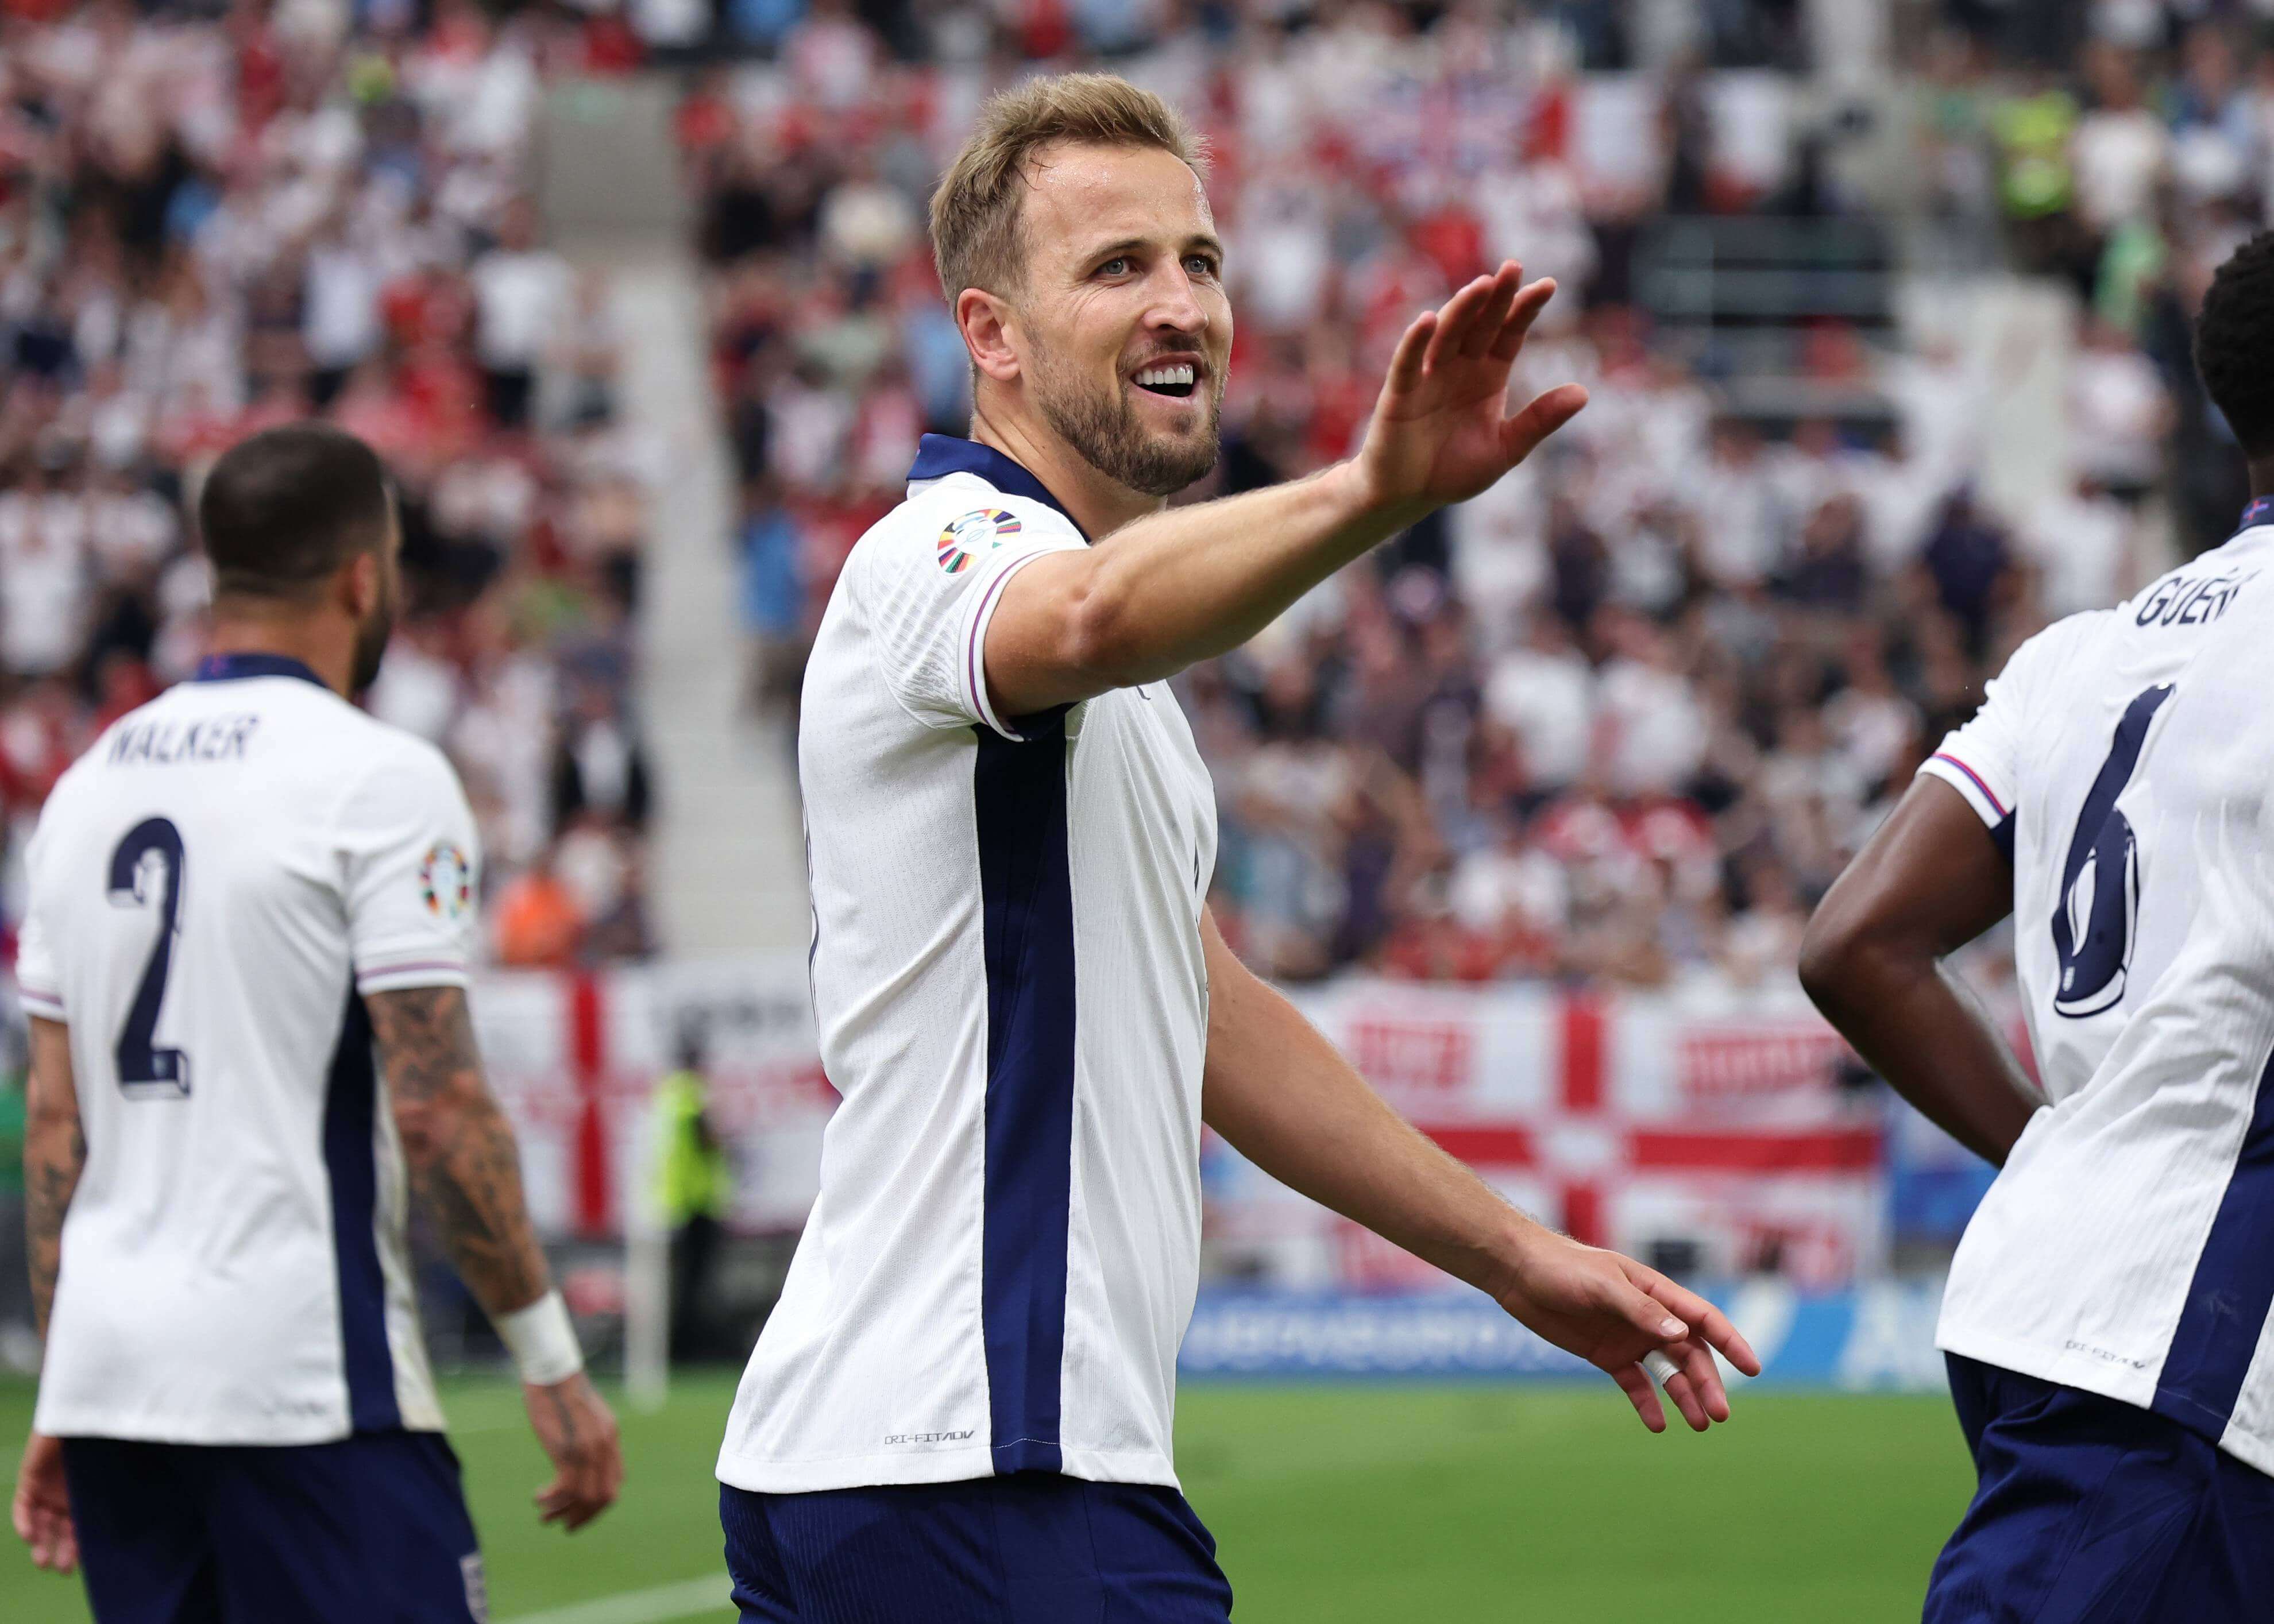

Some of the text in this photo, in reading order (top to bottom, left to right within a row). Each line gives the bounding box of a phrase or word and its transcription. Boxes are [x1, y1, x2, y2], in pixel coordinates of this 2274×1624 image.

[107, 714, 260, 767] WALKER
[2052, 681, 2176, 1018] 6
[106, 816, 191, 1101] 2
